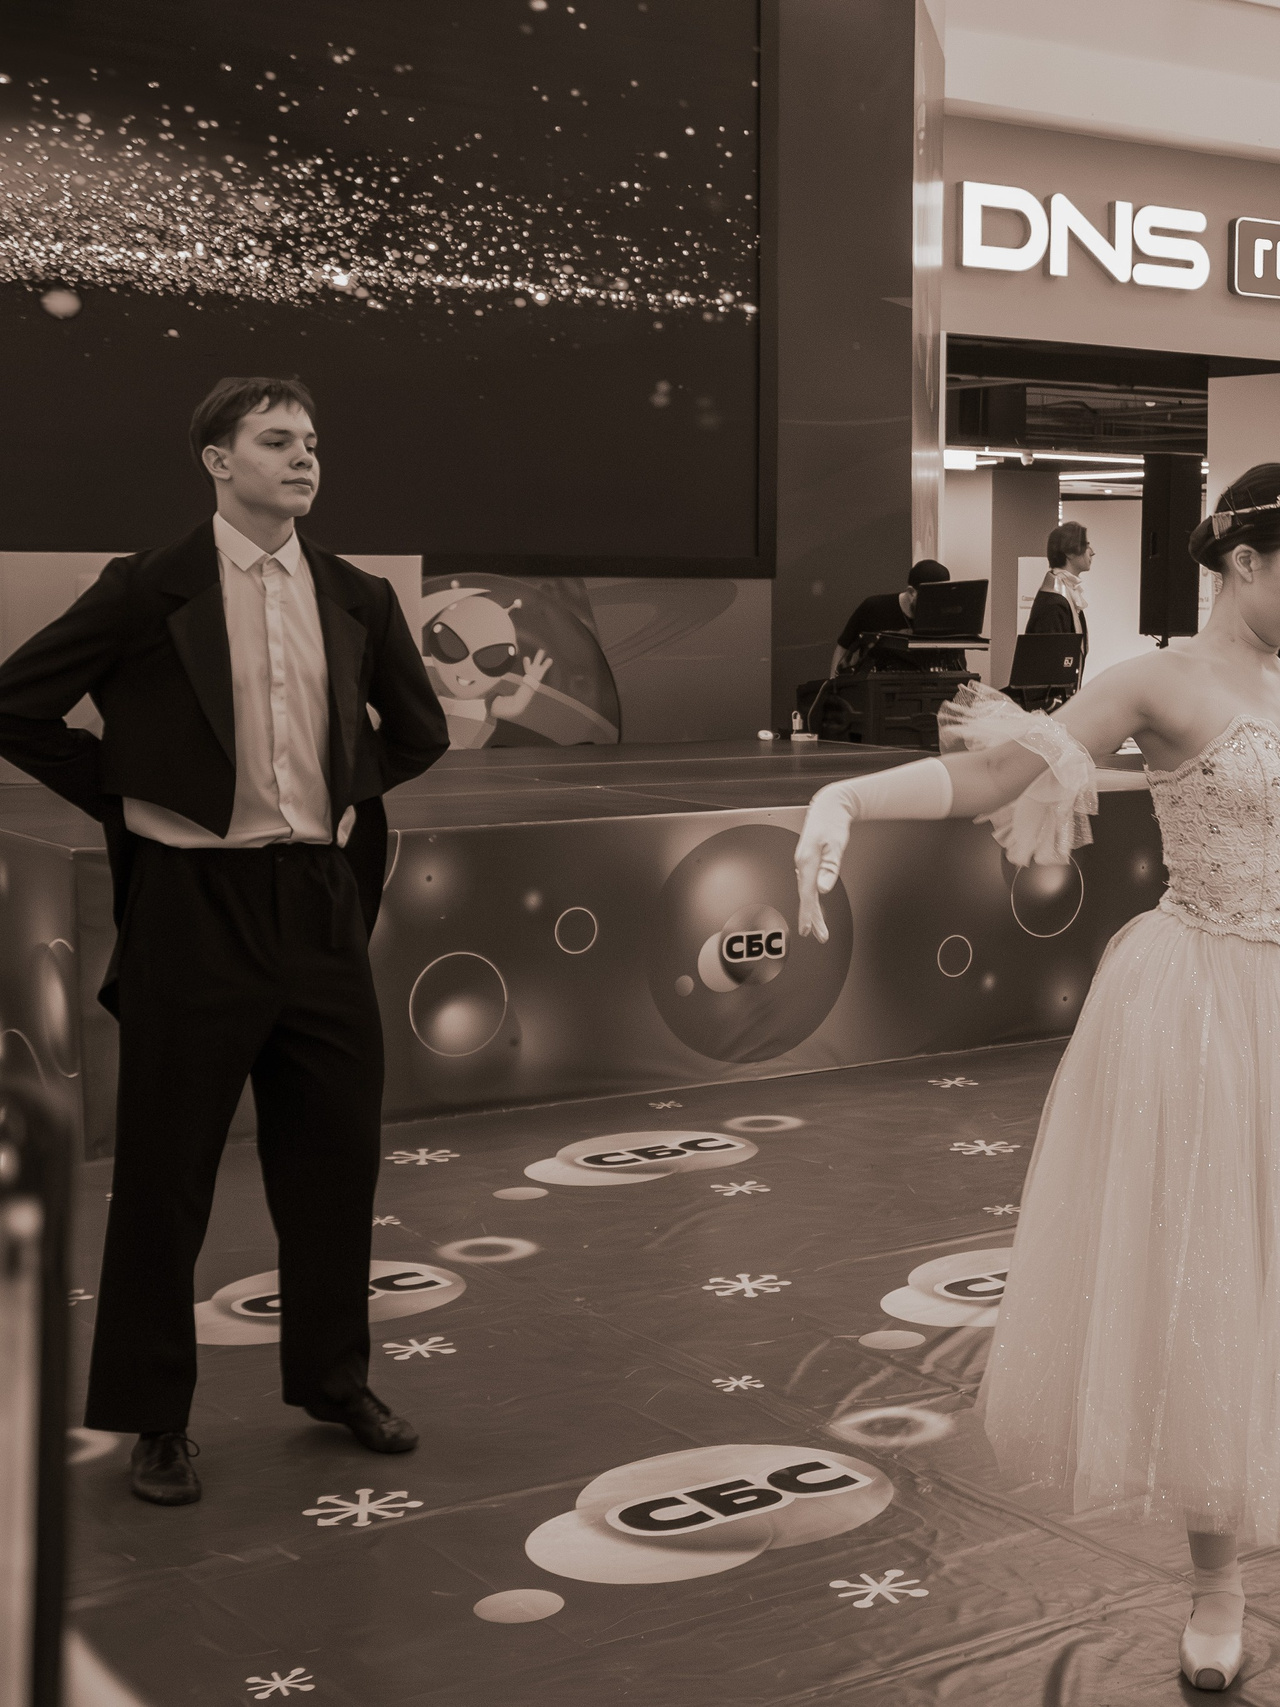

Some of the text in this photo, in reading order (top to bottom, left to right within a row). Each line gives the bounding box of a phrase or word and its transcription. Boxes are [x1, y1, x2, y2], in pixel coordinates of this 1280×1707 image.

[961, 180, 1211, 291] DNS
[725, 931, 783, 960] СБС
[581, 1137, 736, 1168] СБС
[240, 1271, 443, 1314] СС
[617, 1460, 862, 1533] СБС
